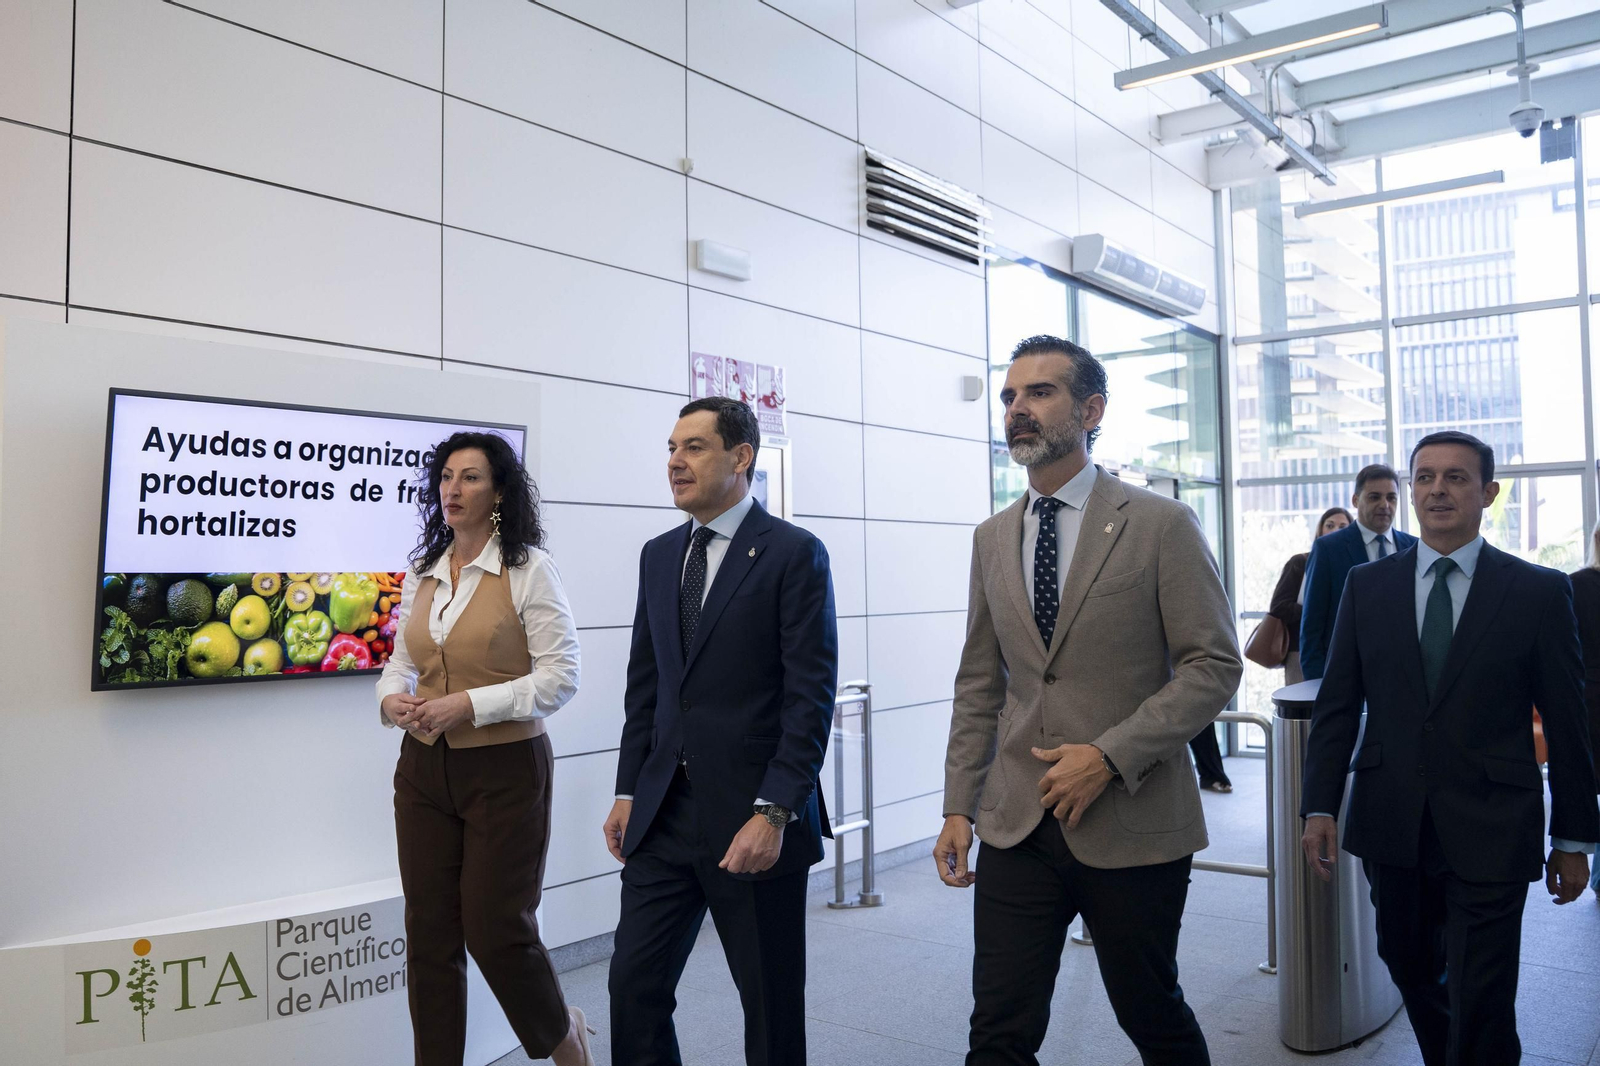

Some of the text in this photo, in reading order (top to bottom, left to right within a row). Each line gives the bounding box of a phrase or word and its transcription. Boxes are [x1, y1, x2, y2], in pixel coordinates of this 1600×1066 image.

[141, 426, 267, 463] Ayudas
[273, 440, 292, 460] a
[139, 470, 335, 503] productoras
[350, 477, 384, 503] de
[137, 508, 297, 538] hortalizas
[276, 912, 372, 948] Parque
[276, 935, 406, 982] Científico
[276, 960, 407, 1017] de Almerí
